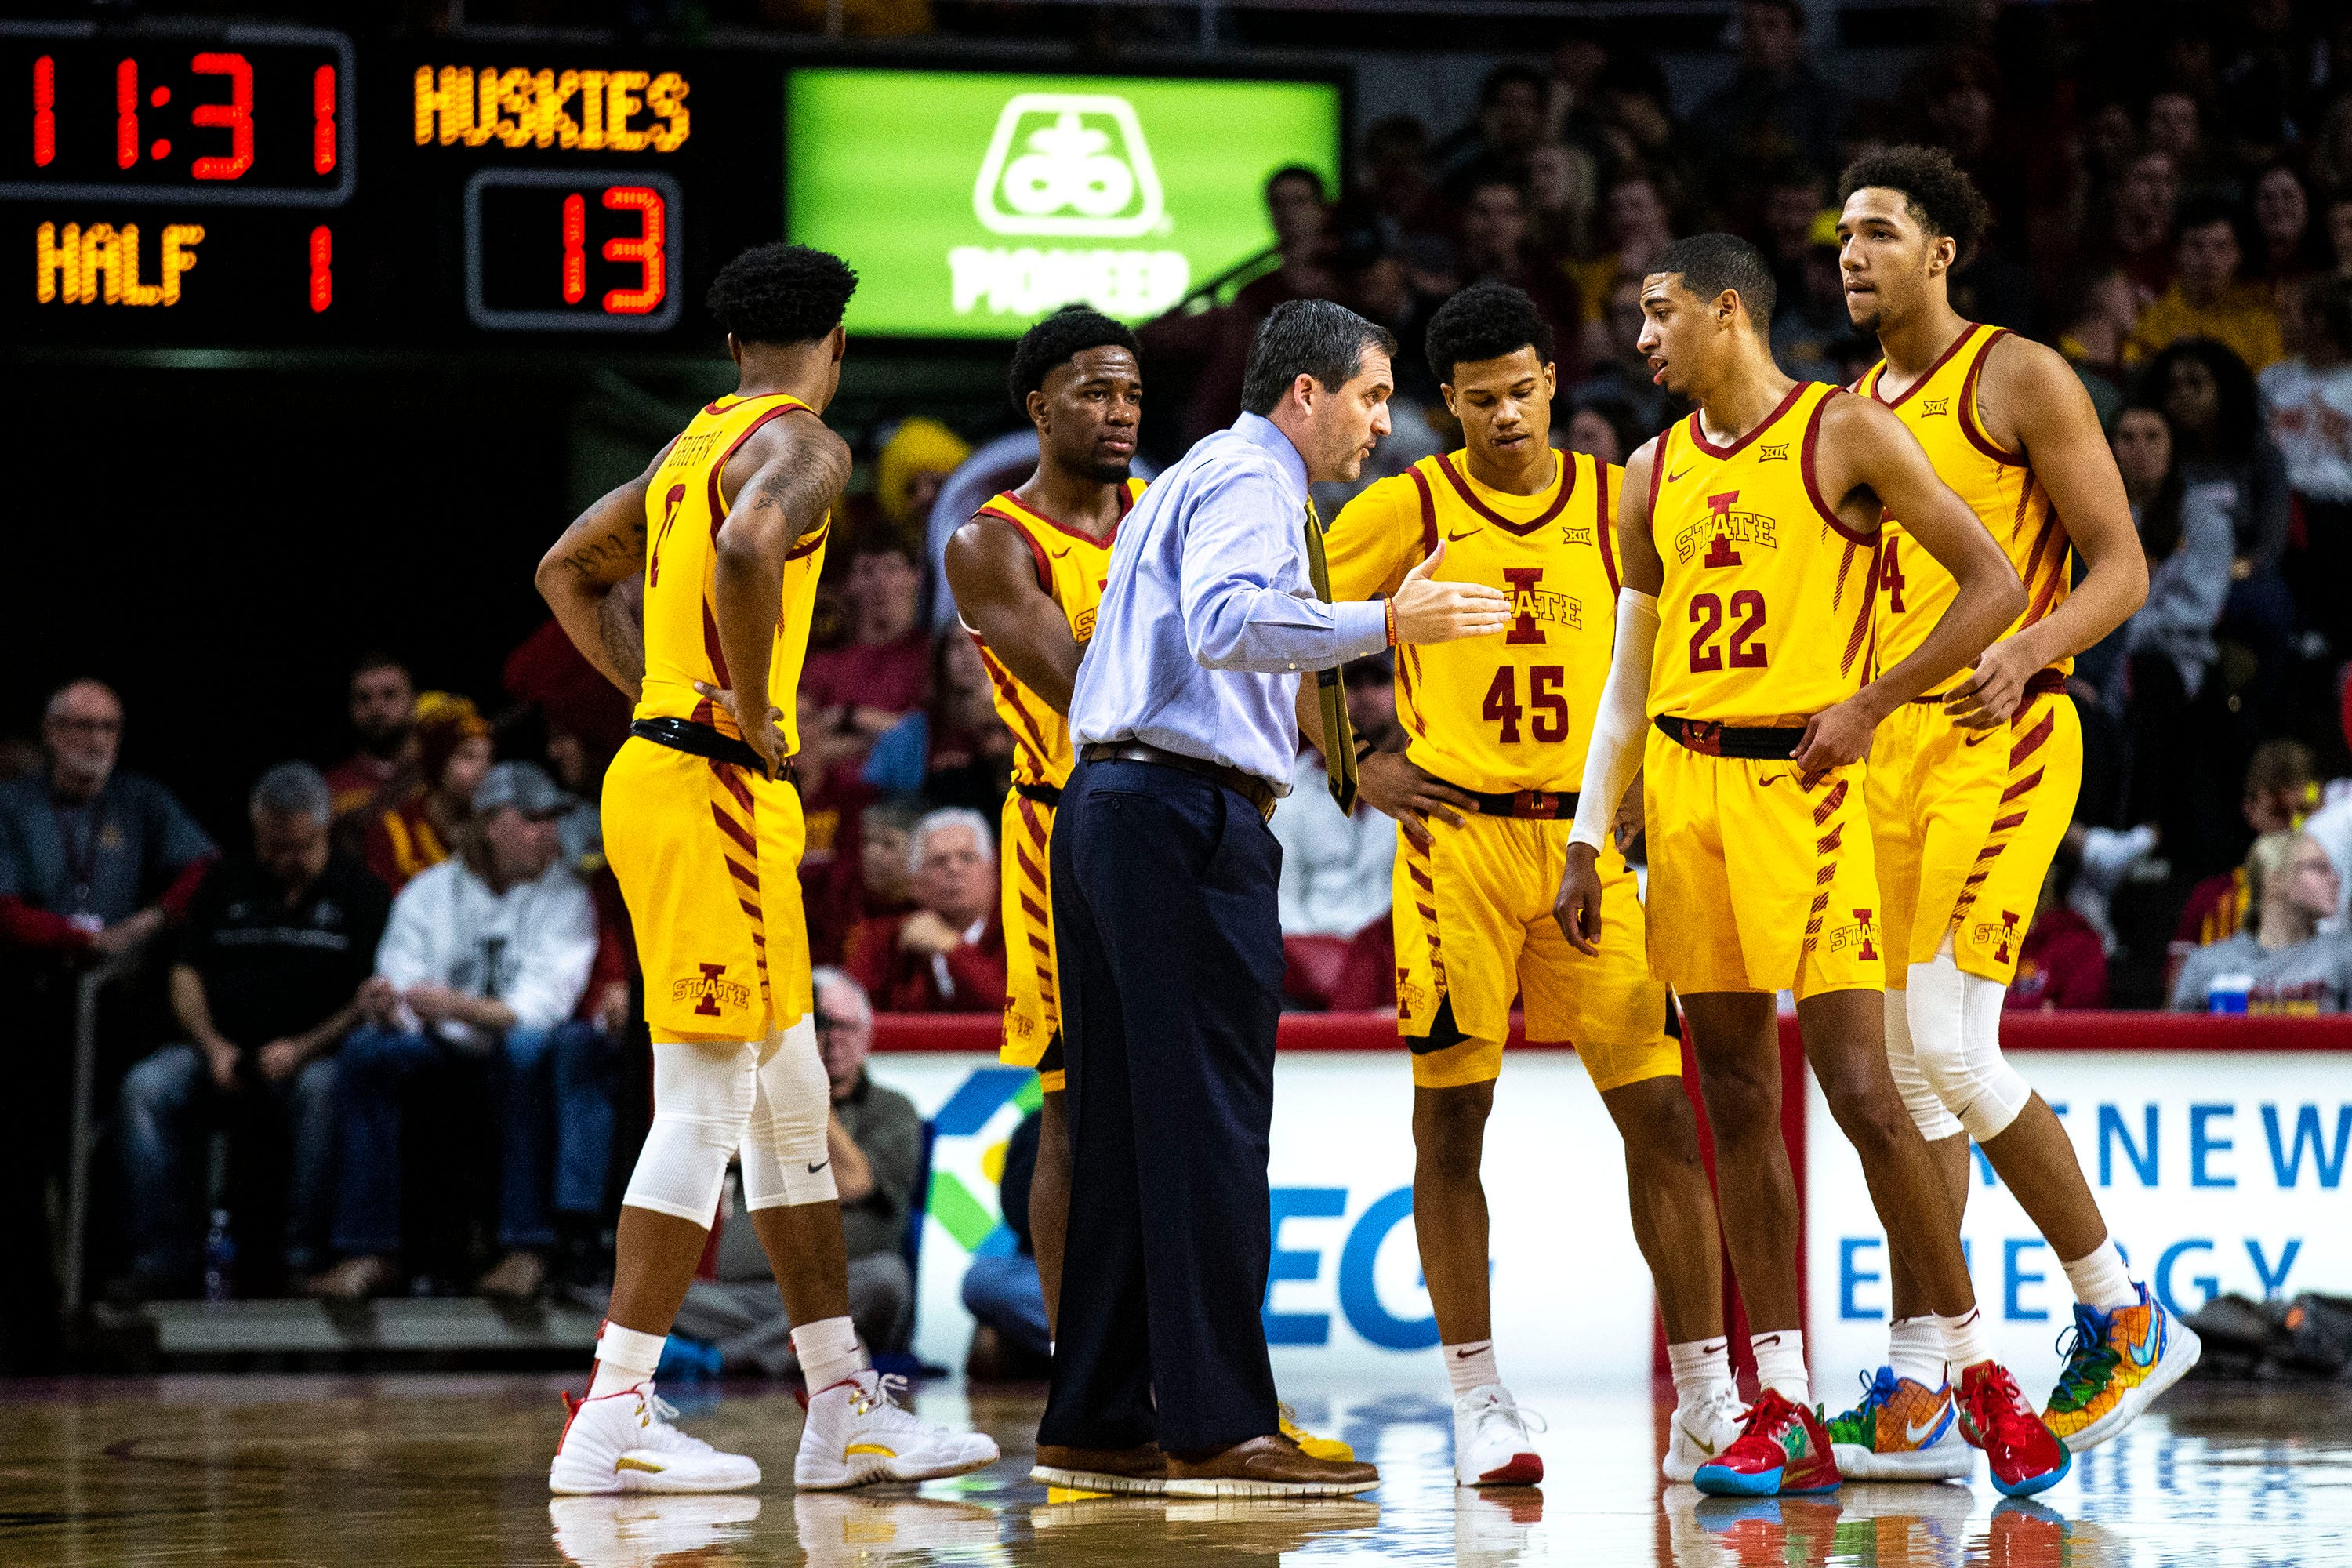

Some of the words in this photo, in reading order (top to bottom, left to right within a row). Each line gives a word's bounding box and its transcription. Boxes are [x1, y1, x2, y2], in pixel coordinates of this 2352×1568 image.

[34, 53, 336, 180] 11:31
[414, 64, 691, 153] HUSKIES
[37, 221, 205, 307] HALF
[310, 225, 332, 313] 1
[563, 186, 666, 314] 13
[1922, 397, 1949, 418] XII
[1759, 443, 1790, 463] XII
[1563, 527, 1592, 545] XII
[1675, 512, 1777, 565] STATE
[1503, 590, 1582, 630] ATE
[1689, 590, 1769, 673] 22
[1482, 666, 1569, 744] 45
[1830, 924, 1882, 953] STAT
[1973, 924, 2022, 953] STAT
[672, 977, 750, 1010] STATE
[1838, 1237, 2302, 1324] EEGY
